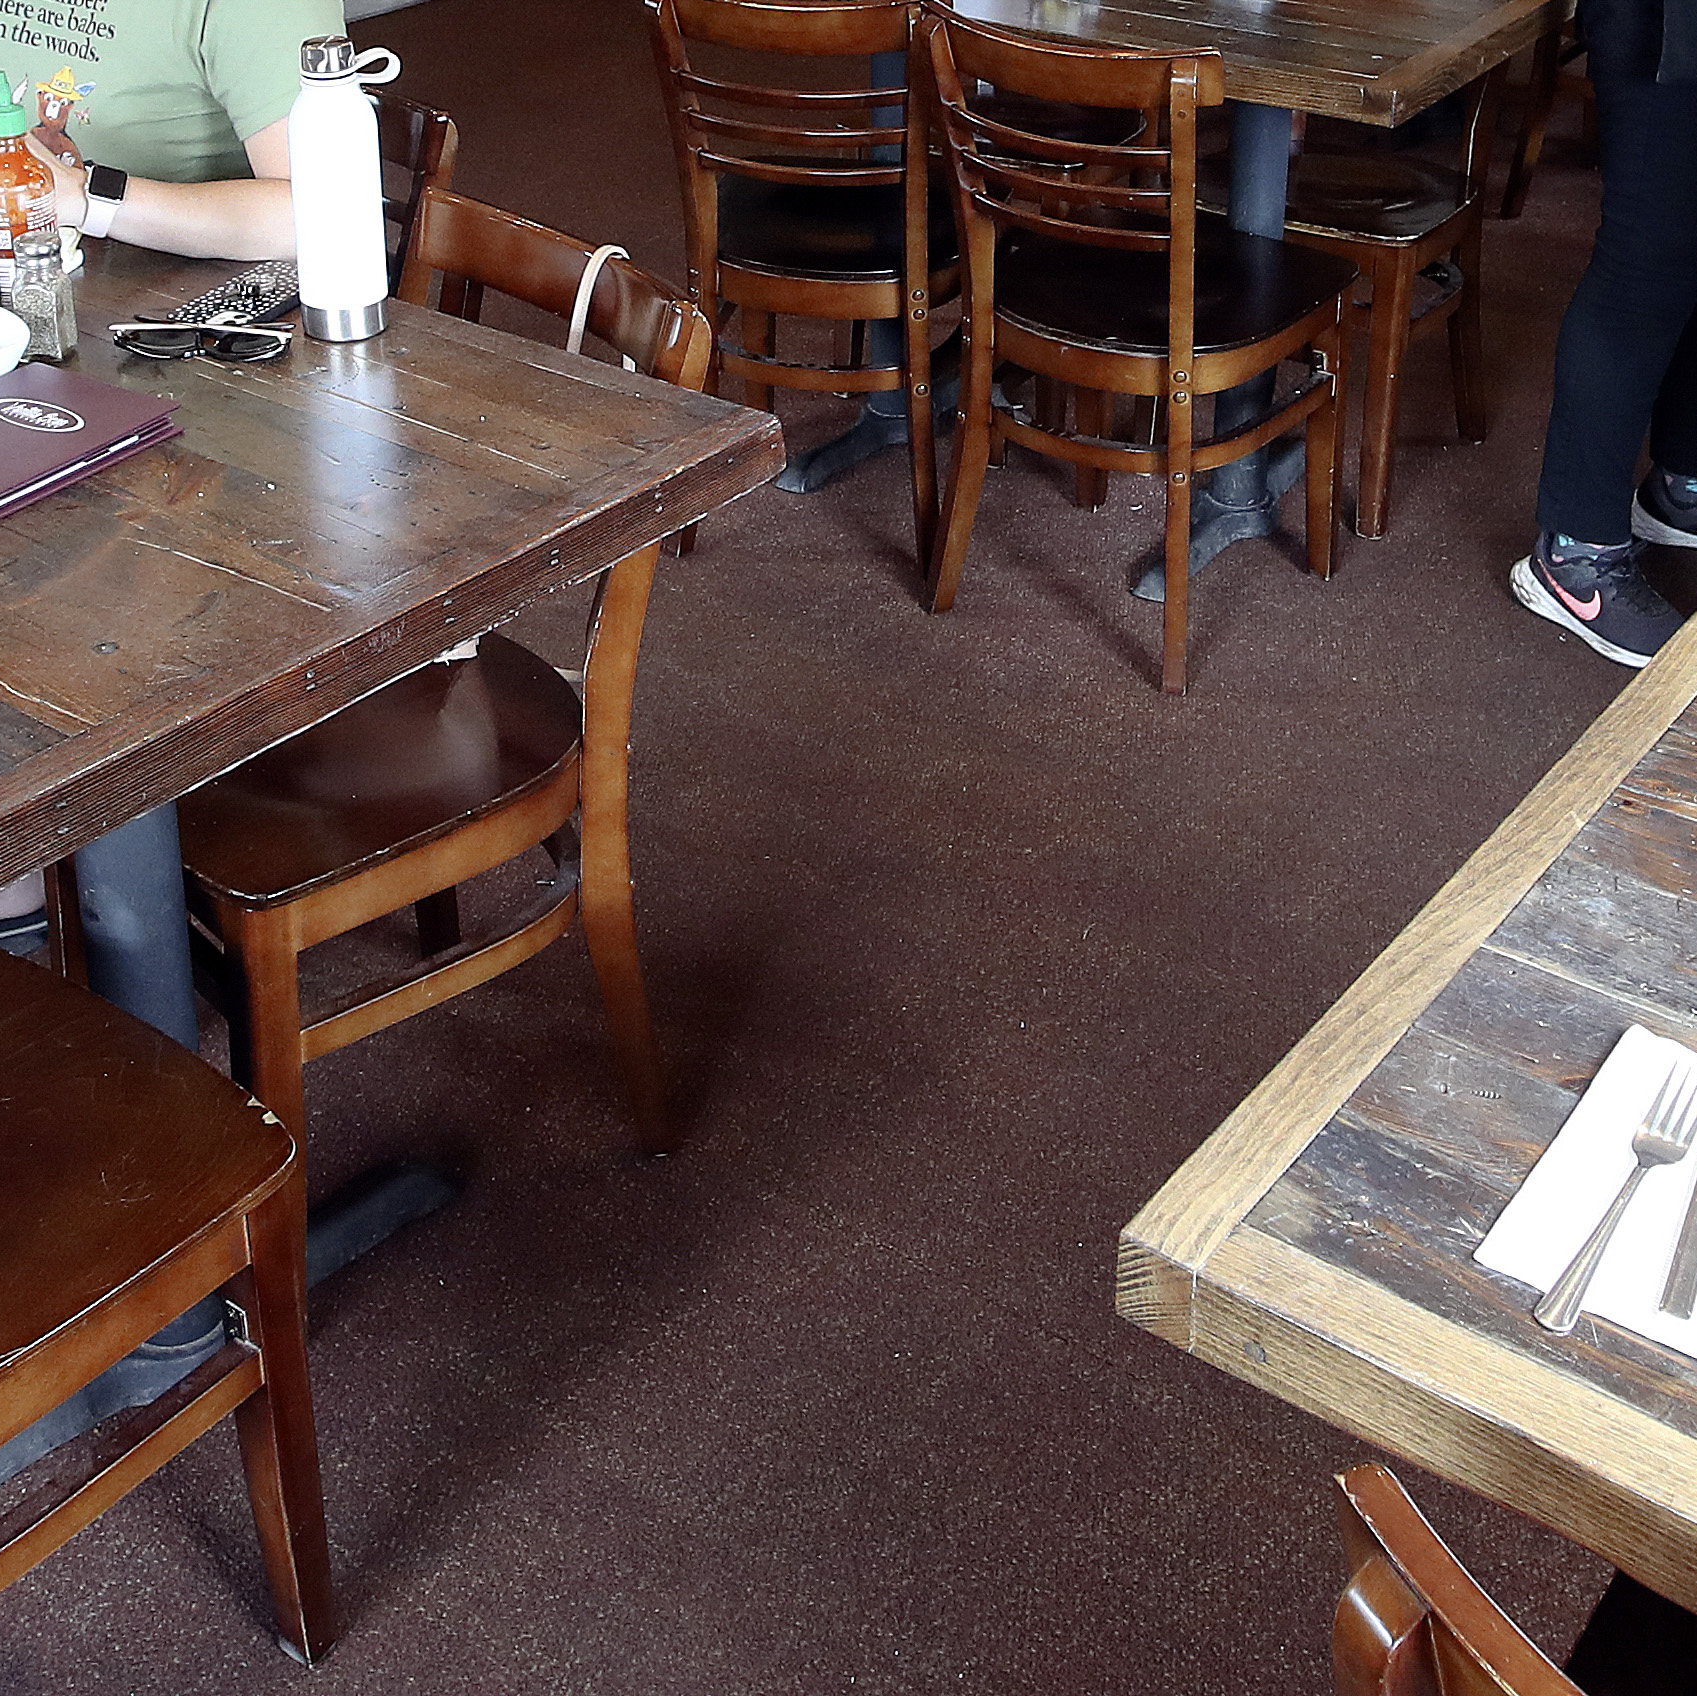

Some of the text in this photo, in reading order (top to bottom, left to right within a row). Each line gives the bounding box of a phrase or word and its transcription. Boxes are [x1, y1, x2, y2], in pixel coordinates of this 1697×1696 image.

[11, 19, 42, 47] the
[45, 34, 101, 63] woods.
[37, 5, 64, 28] are
[67, 8, 116, 40] babes
